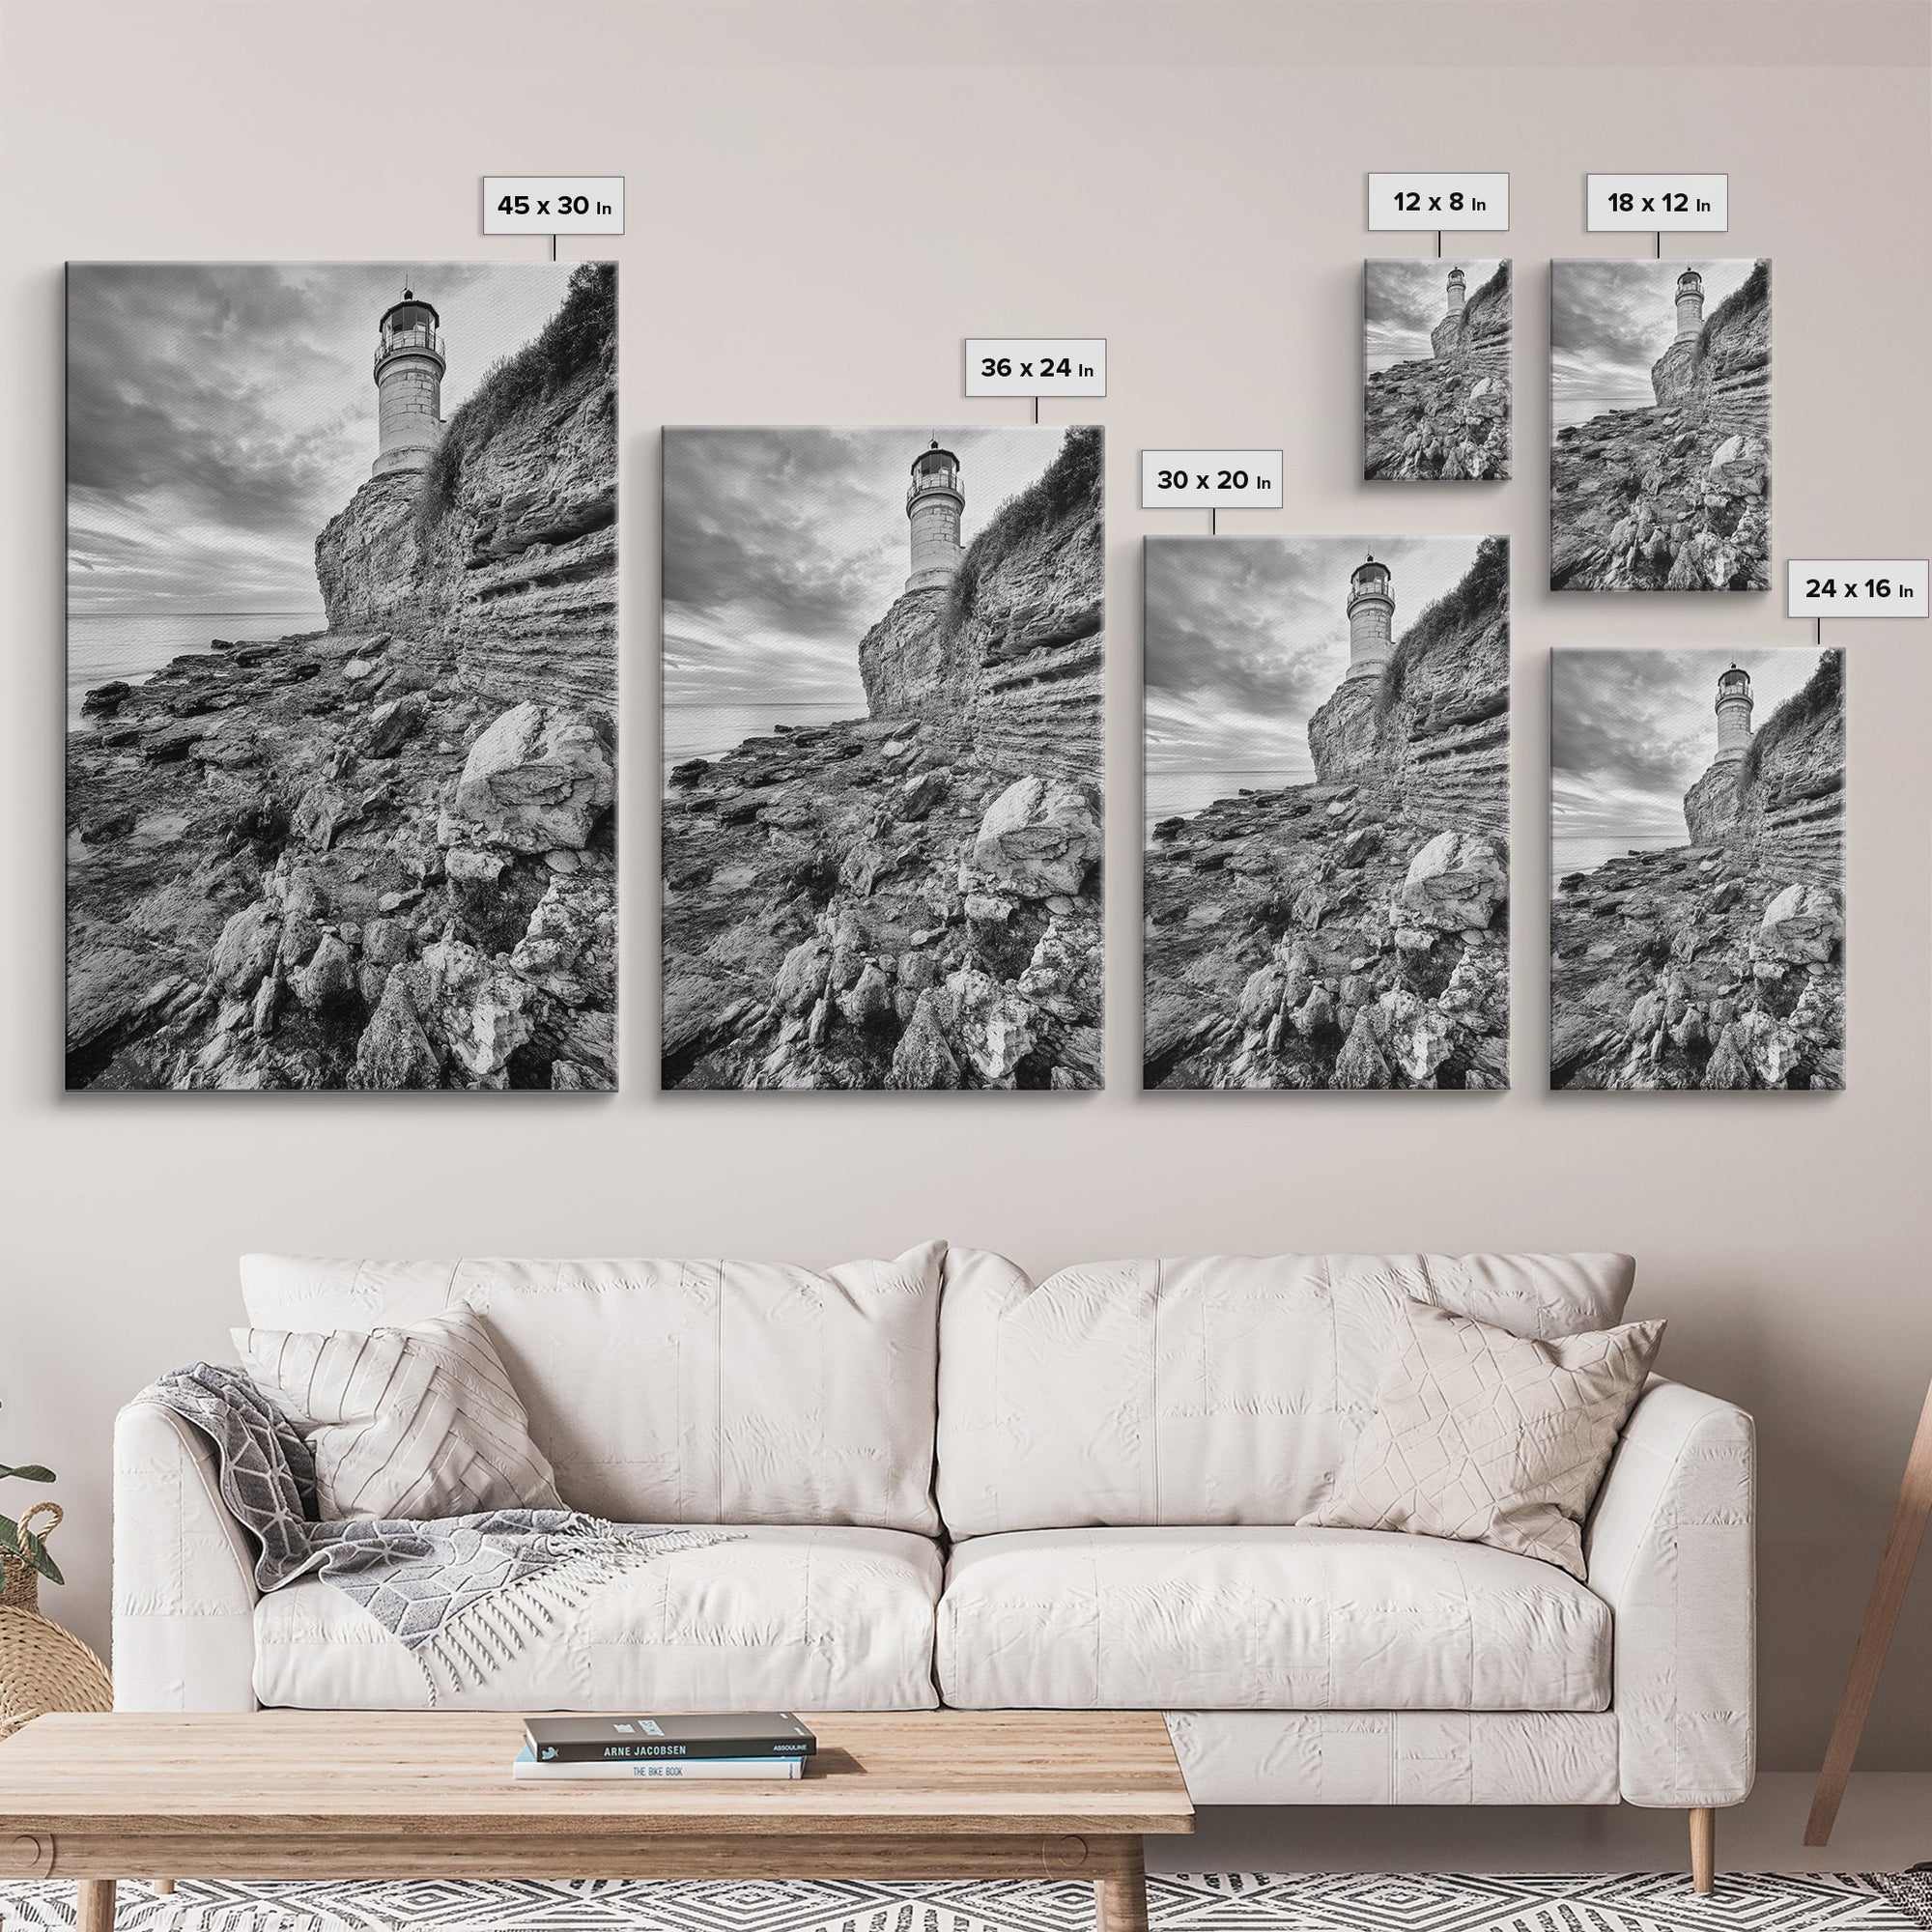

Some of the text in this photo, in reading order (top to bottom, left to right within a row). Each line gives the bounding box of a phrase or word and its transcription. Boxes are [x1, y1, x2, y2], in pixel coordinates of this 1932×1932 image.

[604, 1745, 687, 1756] ARNE JACOBSEN
[773, 1743, 808, 1751] ASSOULINE
[633, 1766, 683, 1776] THE BIKE BOOK
